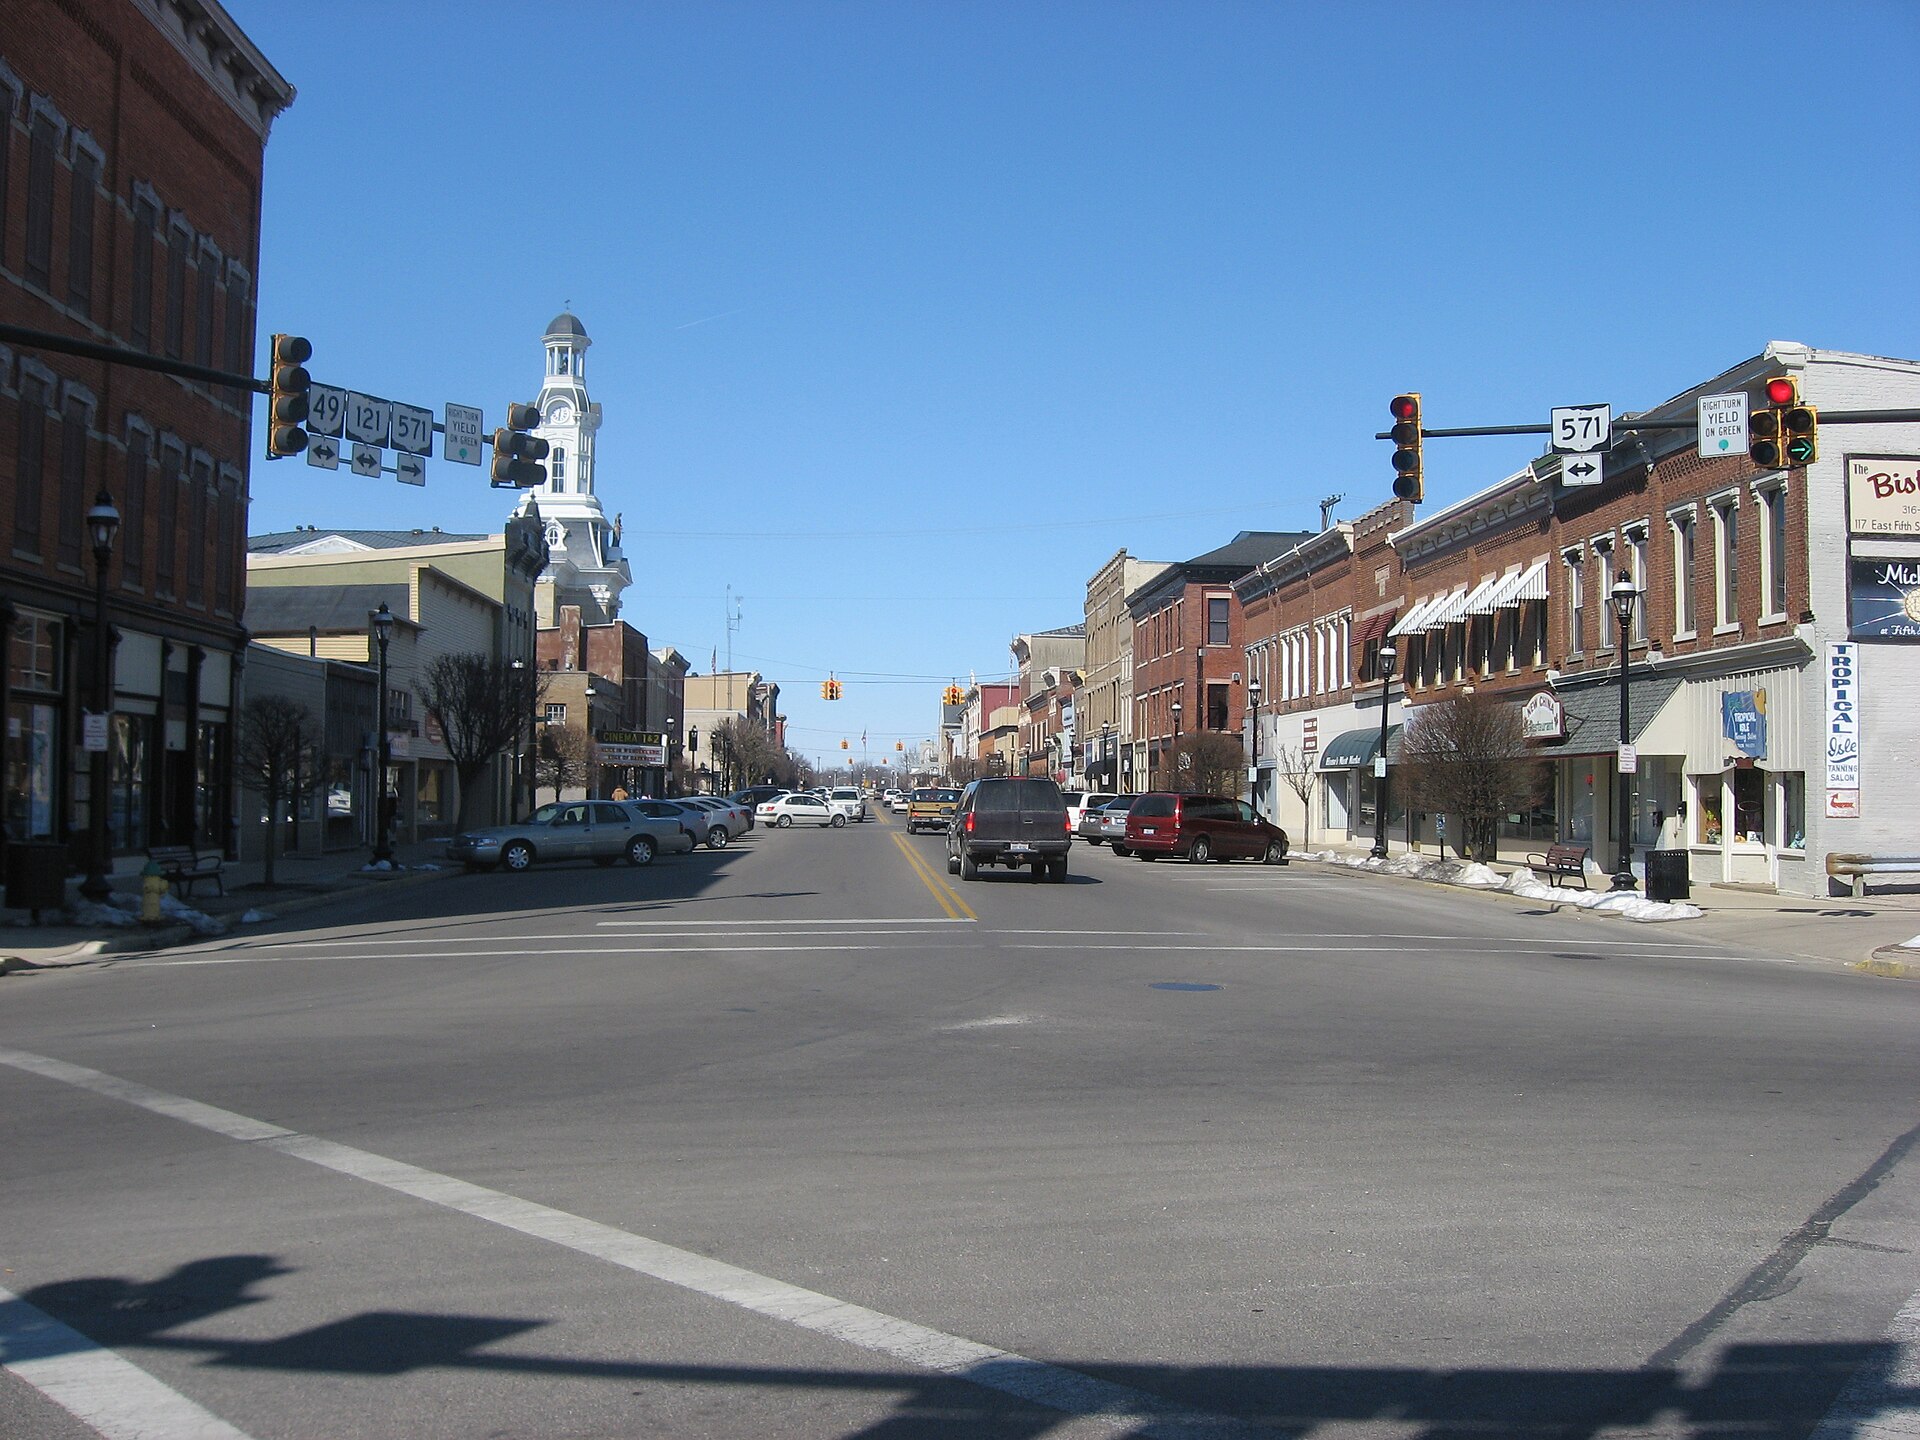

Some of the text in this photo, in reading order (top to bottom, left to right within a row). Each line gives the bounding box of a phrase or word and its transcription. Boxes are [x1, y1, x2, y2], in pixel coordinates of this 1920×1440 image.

[313, 393, 339, 422] 49
[1702, 398, 1742, 411] RIGHT TURN
[356, 405, 380, 432] 121
[1708, 411, 1739, 425] YIELD
[398, 414, 426, 442] 571
[452, 420, 477, 435] YIELD
[1561, 416, 1601, 441] 571
[1705, 424, 1742, 438] ON GREEN
[450, 433, 478, 447] ON GREEN
[1853, 463, 1869, 475] The
[1855, 519, 1867, 530] 117
[1871, 519, 1892, 531] East
[1894, 520, 1912, 531] Fifth
[1891, 624, 1916, 636] Fifth
[1832, 645, 1853, 734] TROPICAL
[1734, 711, 1756, 722] TROPICAL
[604, 732, 637, 743] CINEMA
[1828, 737, 1857, 757] Isle
[1828, 764, 1858, 773] TANNING
[1830, 774, 1855, 782] SALON
